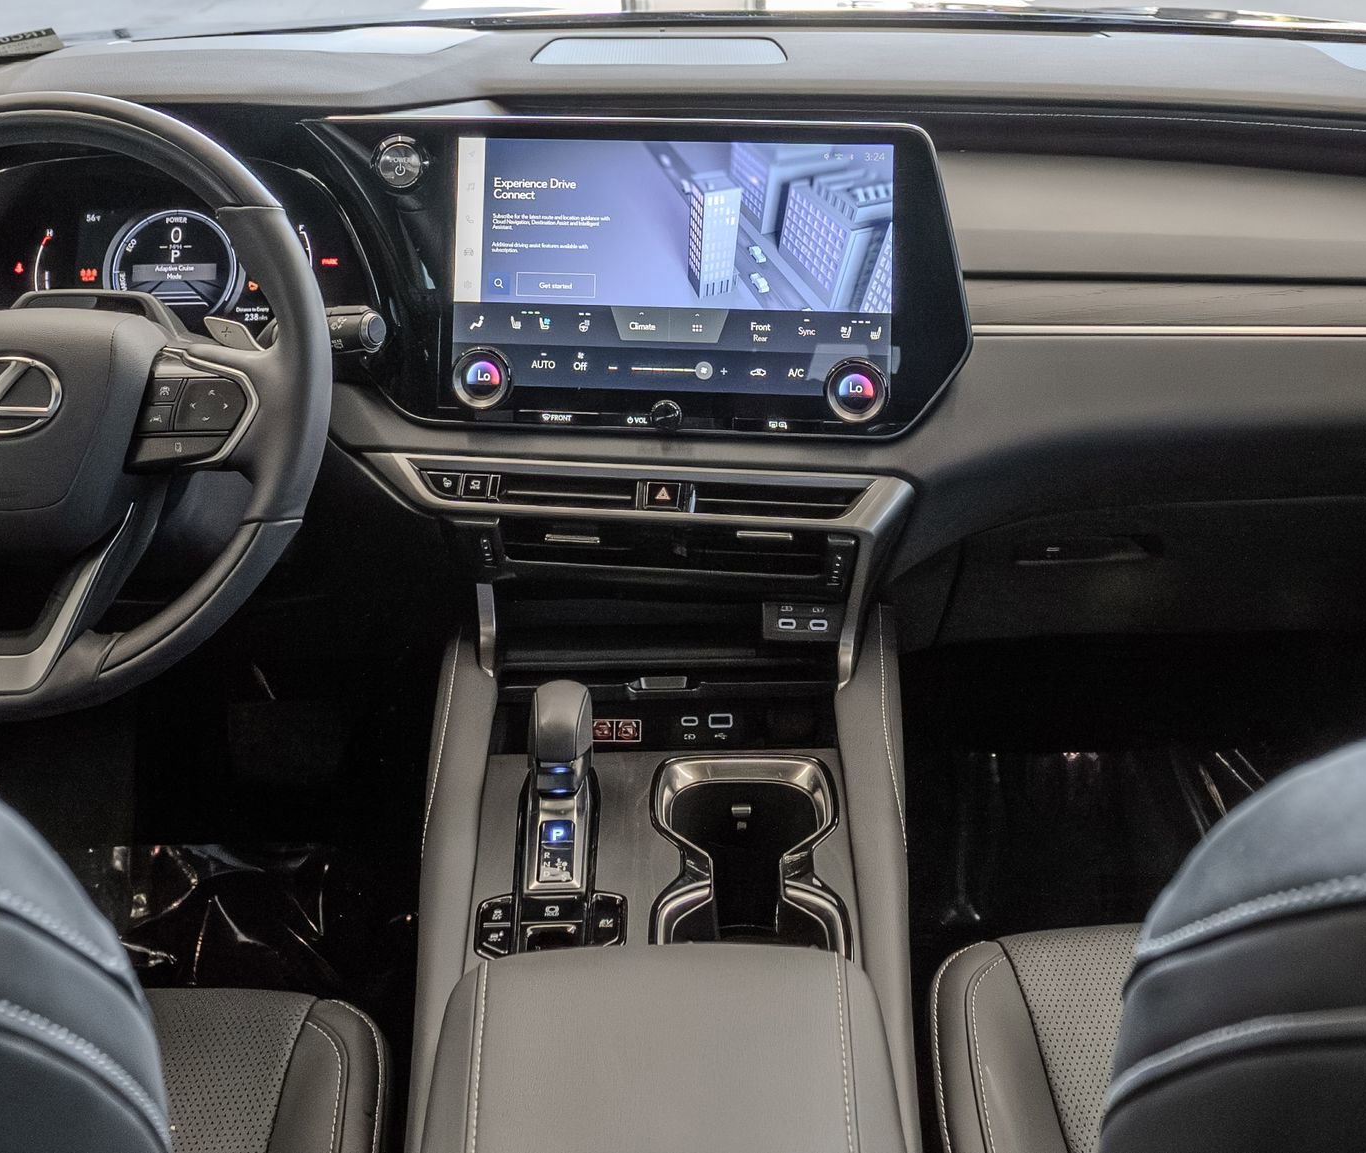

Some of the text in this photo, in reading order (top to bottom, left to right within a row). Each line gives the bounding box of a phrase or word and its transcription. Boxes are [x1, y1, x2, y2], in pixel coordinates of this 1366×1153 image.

[864, 152, 885, 161] 3:24
[493, 177, 576, 189] Experience Drive
[493, 189, 536, 200] Connect
[171, 227, 182, 243] 0
[126, 238, 137, 252] ECO
[171, 250, 180, 263] P
[552, 282, 572, 290] started
[244, 313, 258, 321] 238
[629, 321, 656, 331] Climate
[750, 322, 771, 332] Front
[798, 327, 816, 336] Sync
[753, 334, 768, 342] Rear
[531, 360, 555, 369] AUTO
[573, 361, 587, 371] Off
[477, 370, 491, 382] Lo
[787, 368, 805, 378] A/C
[849, 381, 863, 393] Lo
[551, 414, 572, 422] FRONT
[635, 416, 648, 424] VOL
[552, 829, 564, 841] P
[544, 851, 550, 859] R
